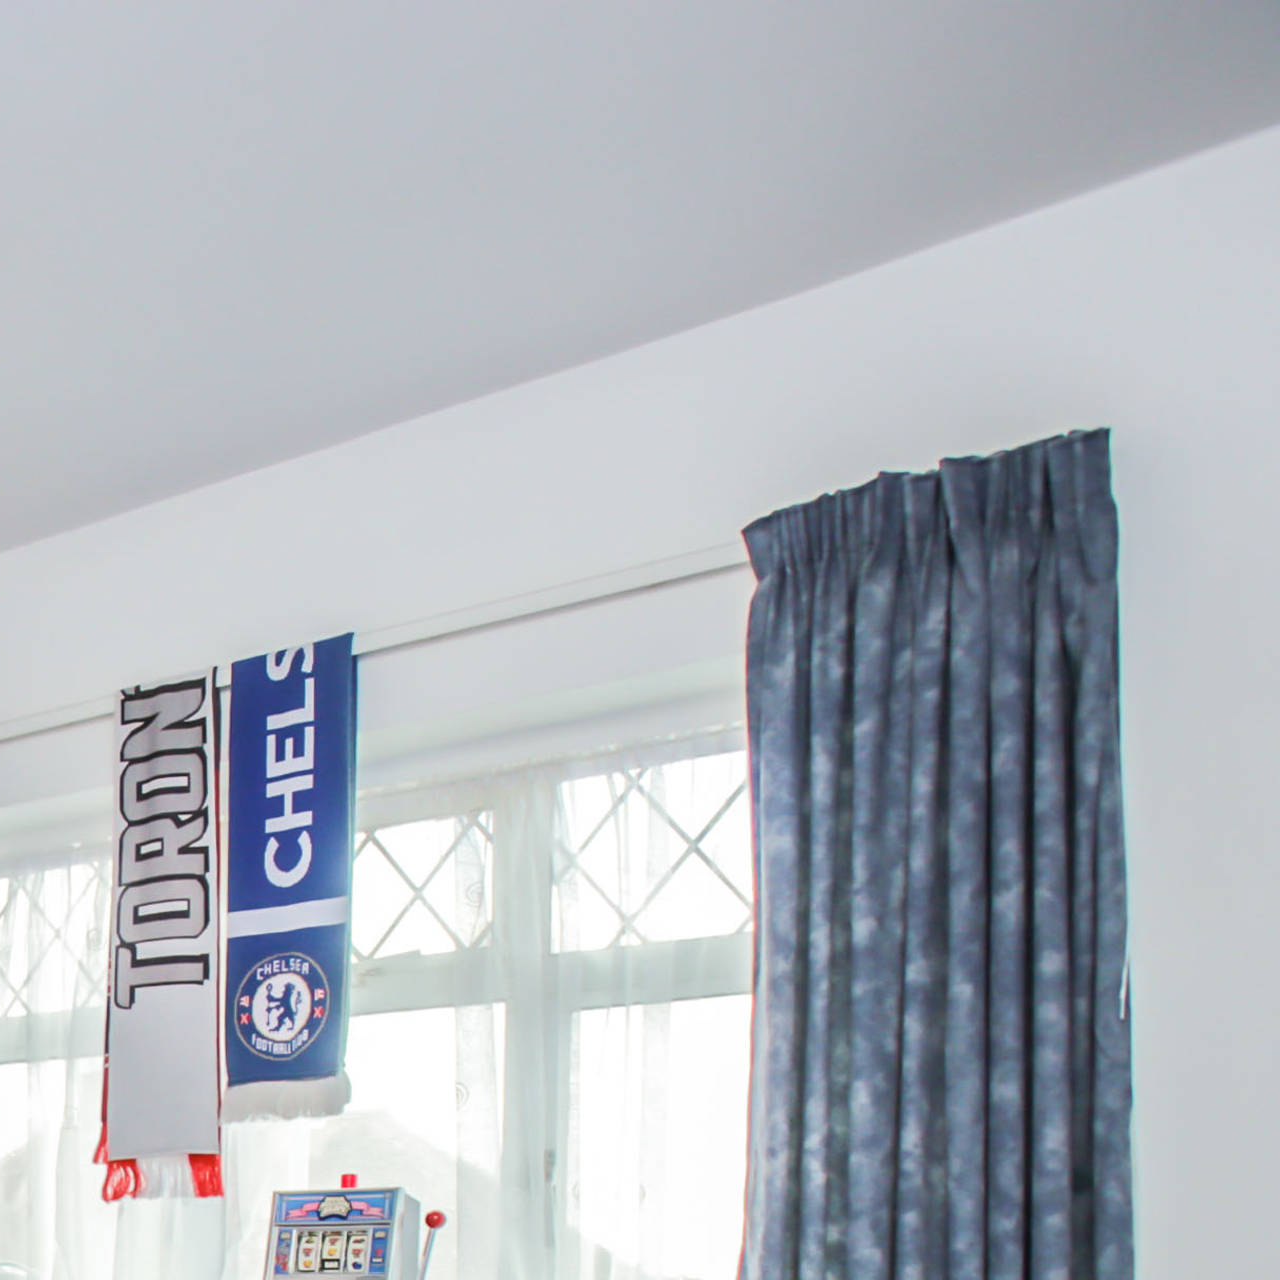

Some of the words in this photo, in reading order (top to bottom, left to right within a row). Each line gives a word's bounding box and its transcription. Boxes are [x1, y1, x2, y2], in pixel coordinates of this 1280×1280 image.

[114, 676, 210, 1010] TORON
[264, 642, 315, 888] CHELS
[256, 958, 310, 980] CHELSEA
